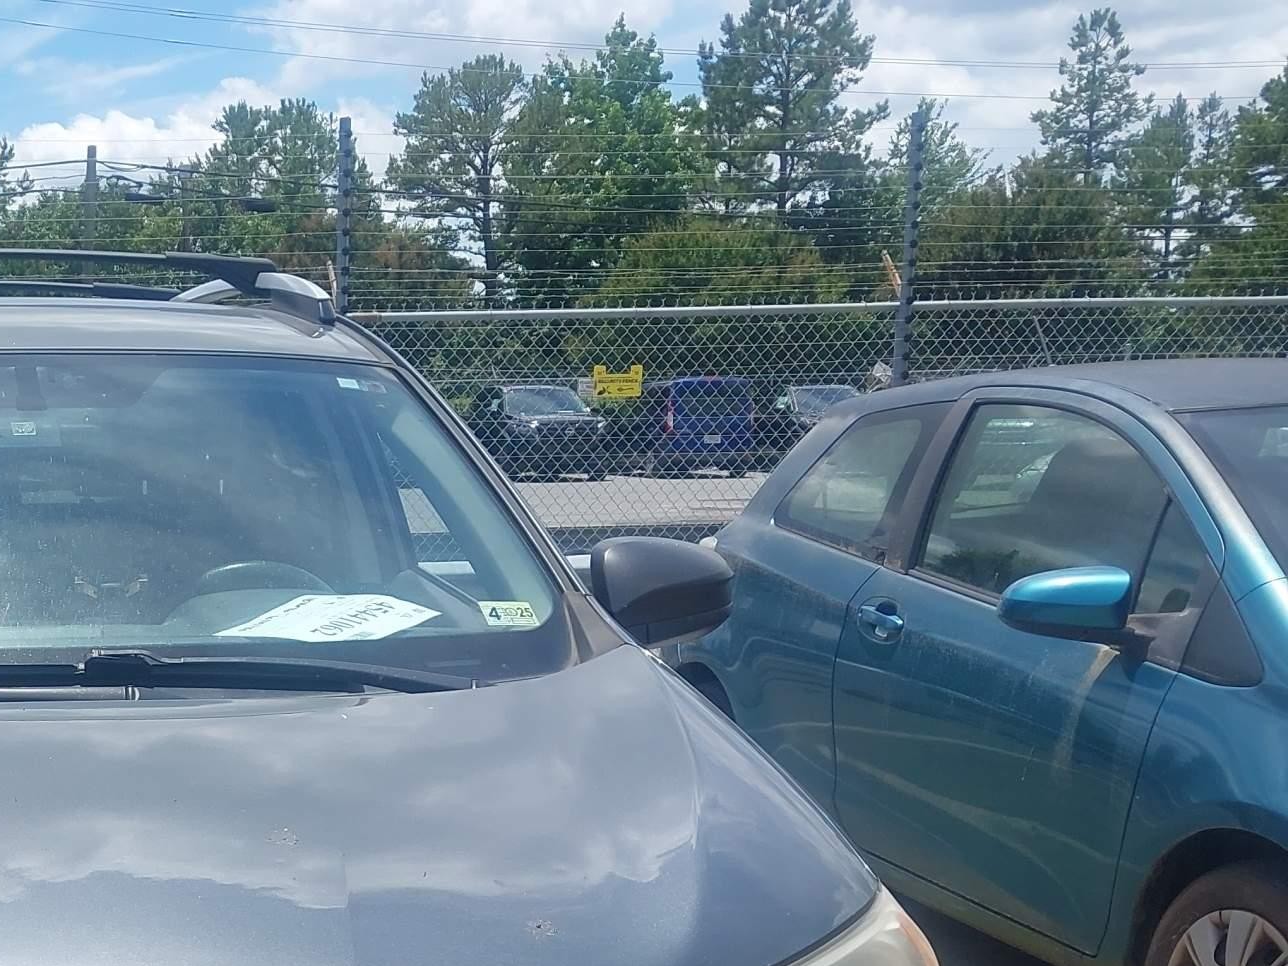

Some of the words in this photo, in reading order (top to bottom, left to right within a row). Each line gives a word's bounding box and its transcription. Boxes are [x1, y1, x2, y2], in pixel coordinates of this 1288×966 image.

[310, 601, 395, 637] 45441062
[489, 607, 501, 620] 4
[517, 607, 533, 617] 25
